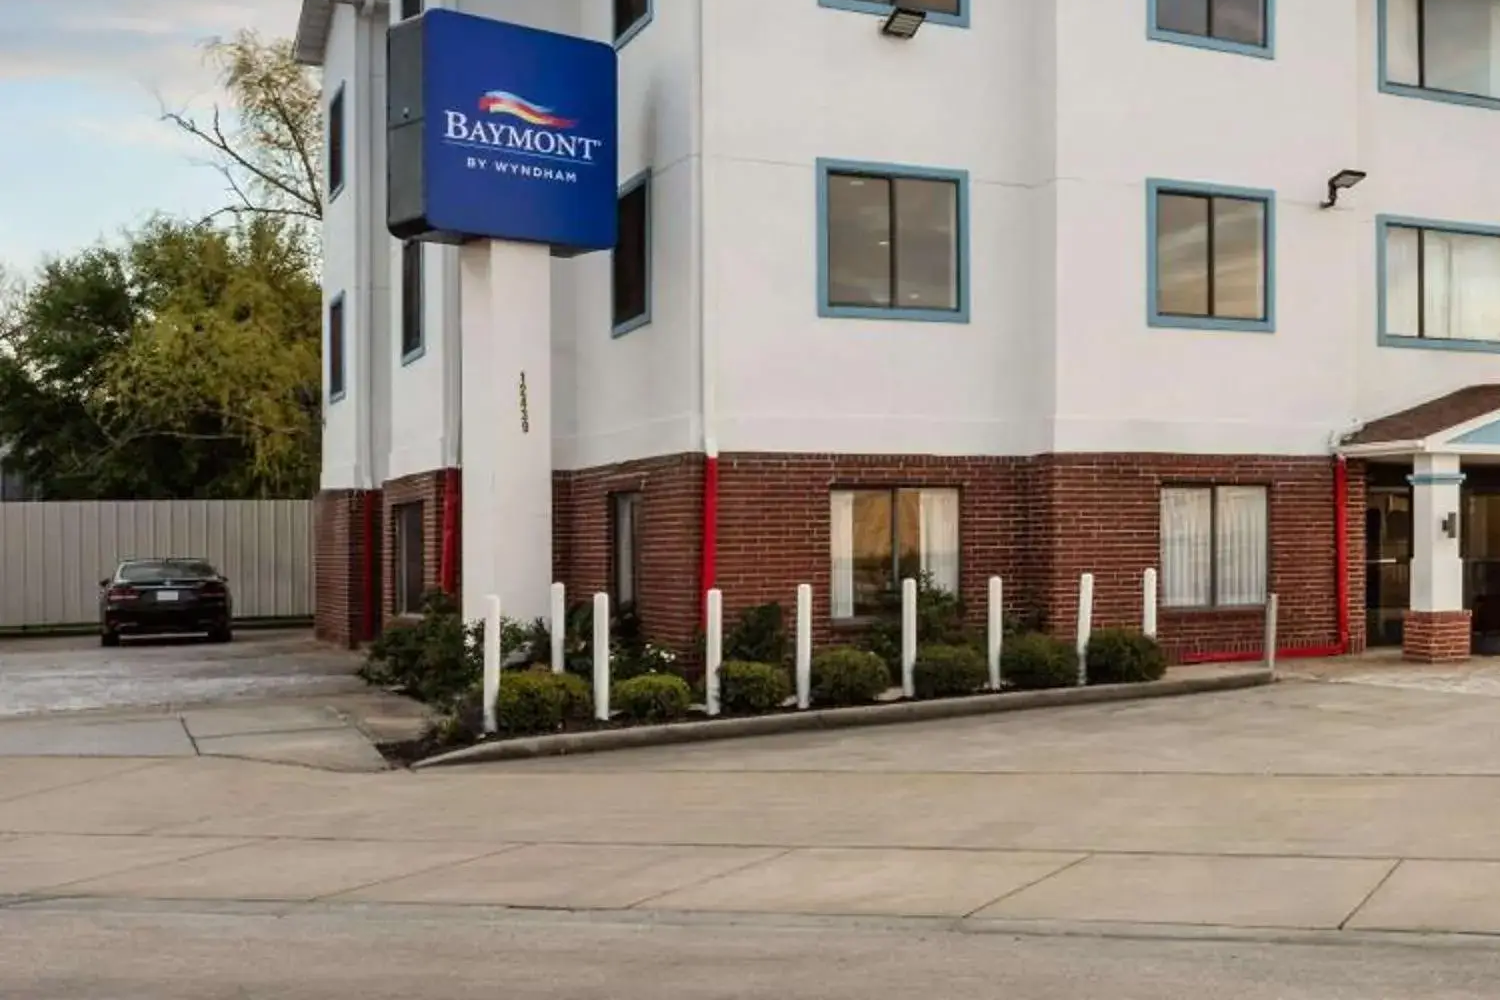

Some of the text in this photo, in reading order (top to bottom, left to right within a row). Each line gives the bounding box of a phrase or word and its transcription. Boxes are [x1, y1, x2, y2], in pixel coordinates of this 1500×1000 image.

[443, 108, 599, 161] BAYMONT
[466, 156, 578, 184] BY WYNDHAM
